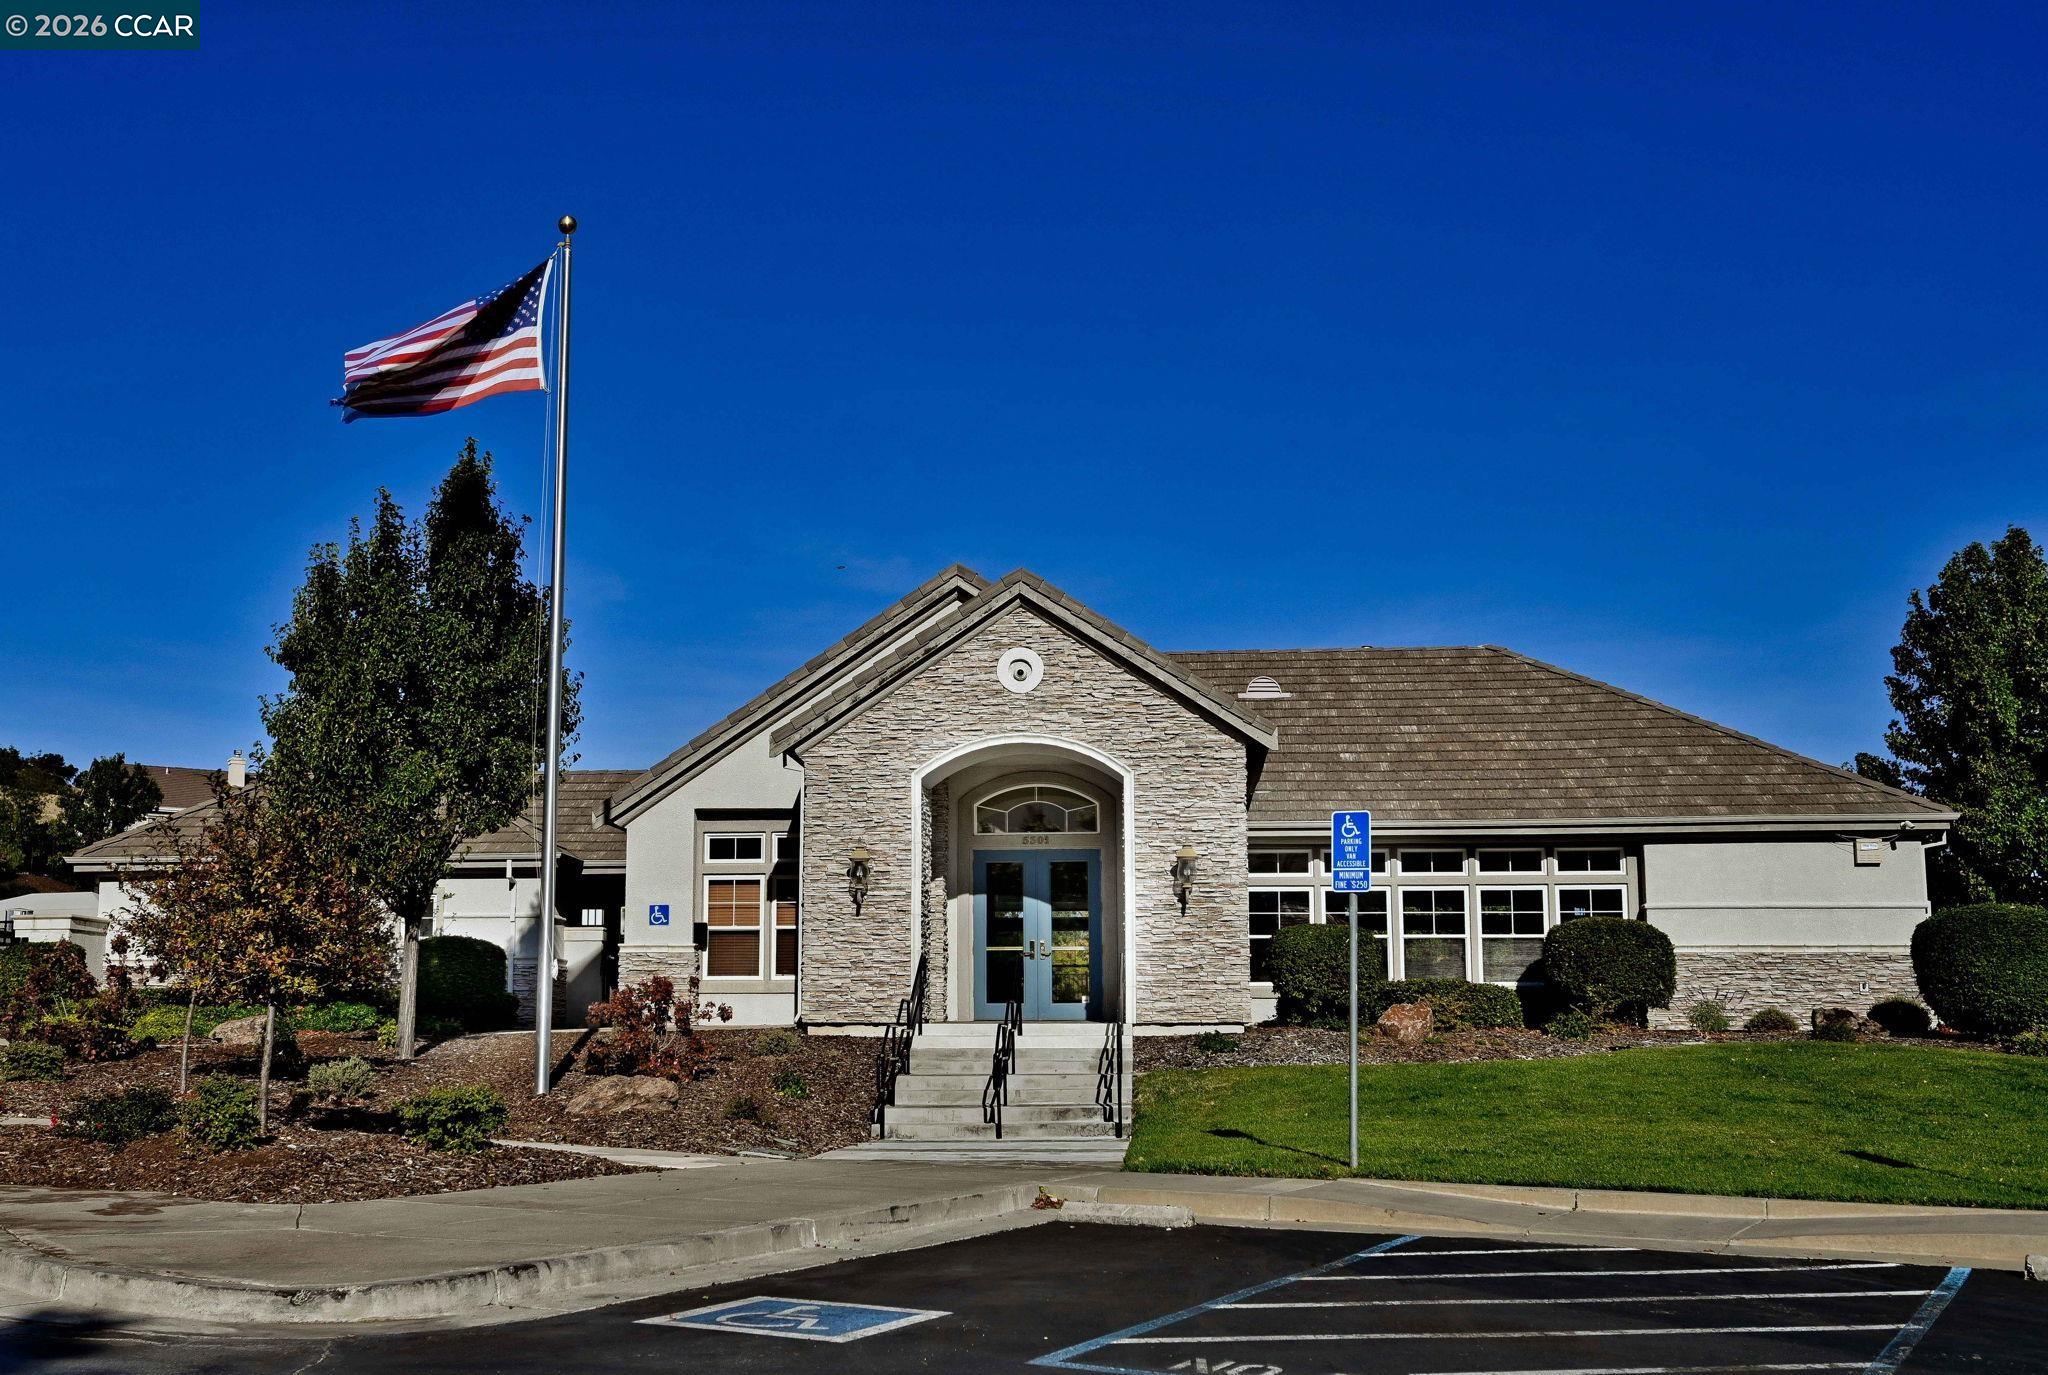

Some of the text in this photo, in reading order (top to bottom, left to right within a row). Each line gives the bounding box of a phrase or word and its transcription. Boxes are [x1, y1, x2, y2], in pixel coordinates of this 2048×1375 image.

[1338, 871, 1364, 879] MINIMUM
[1335, 880, 1367, 889] FINE $250
